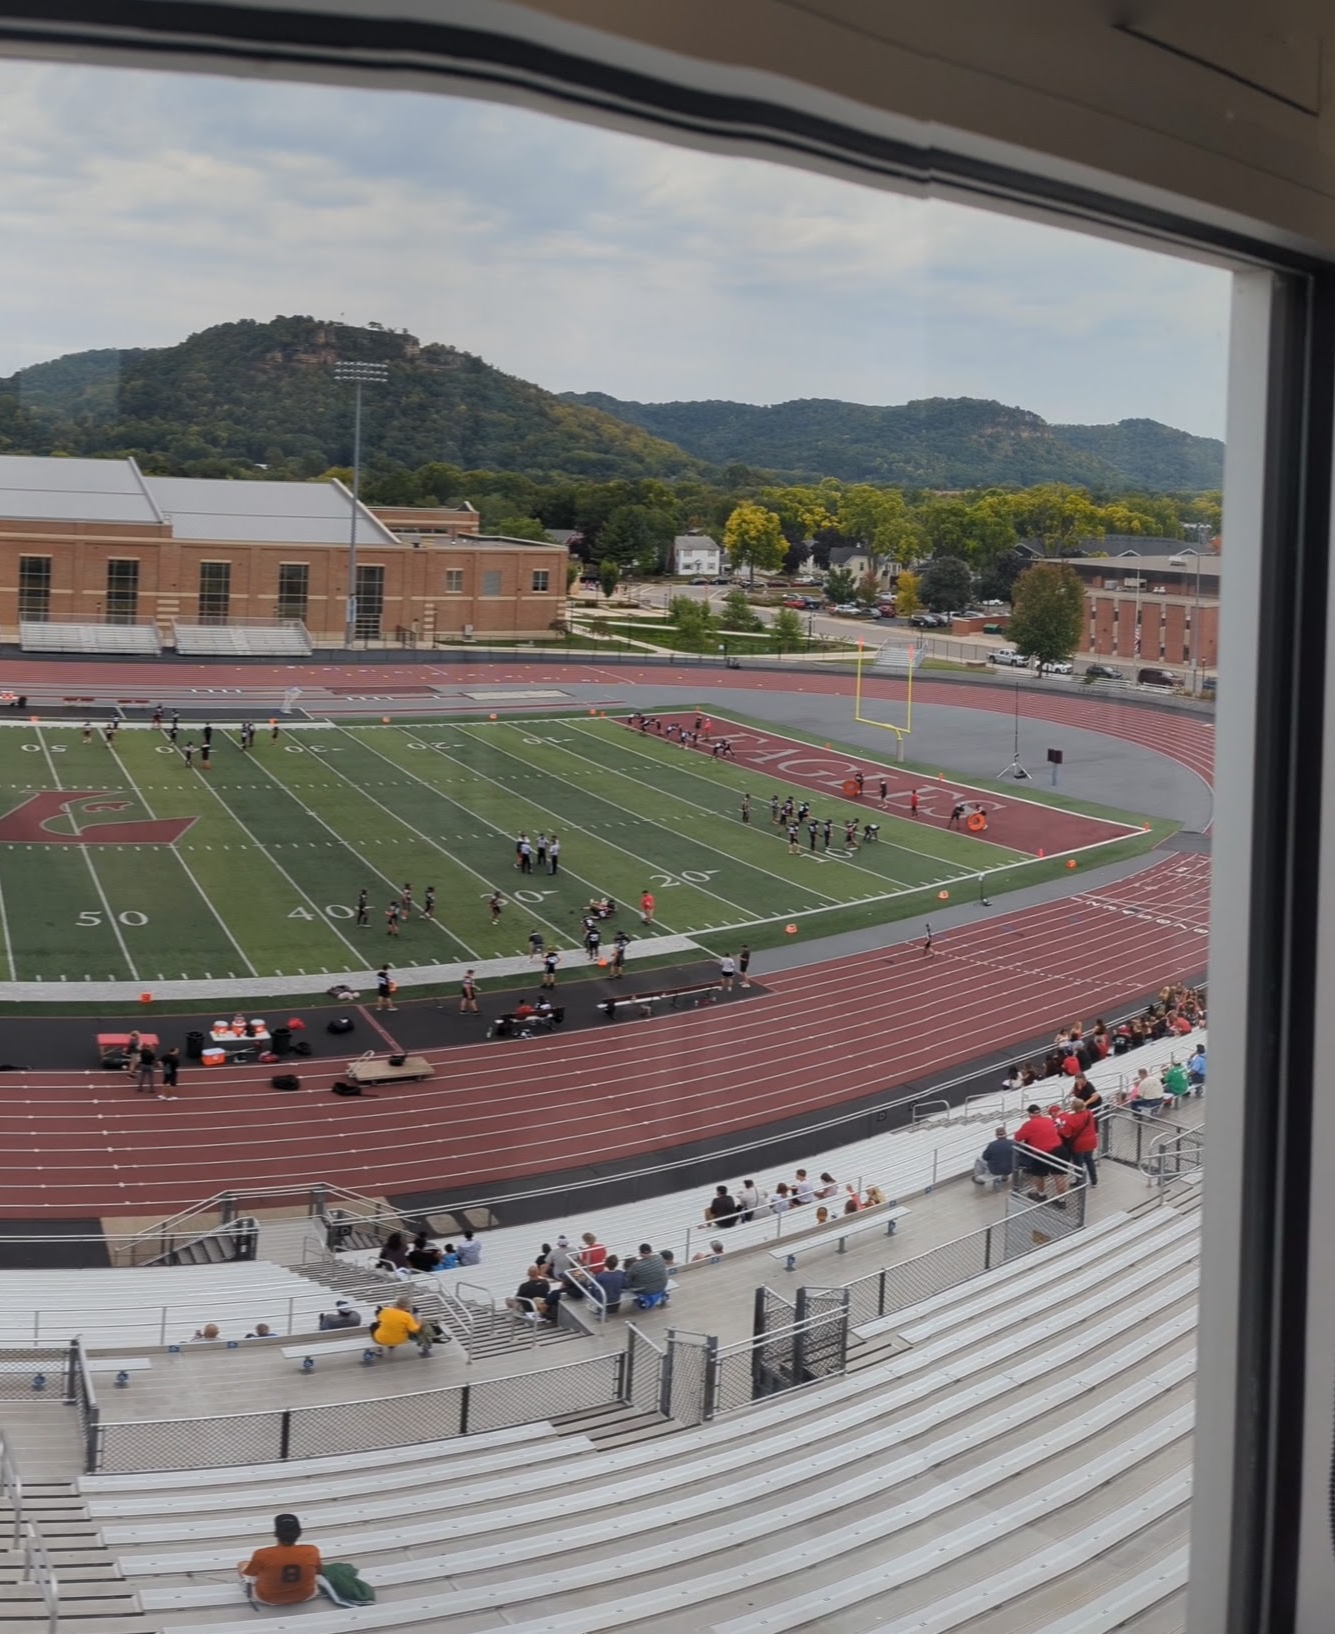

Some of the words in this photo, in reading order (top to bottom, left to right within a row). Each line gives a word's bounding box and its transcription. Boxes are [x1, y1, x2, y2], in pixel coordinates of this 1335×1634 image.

[696, 731, 1008, 820] EAGLES
[649, 869, 713, 888] 20
[74, 910, 150, 927] 50
[287, 904, 357, 921] 40
